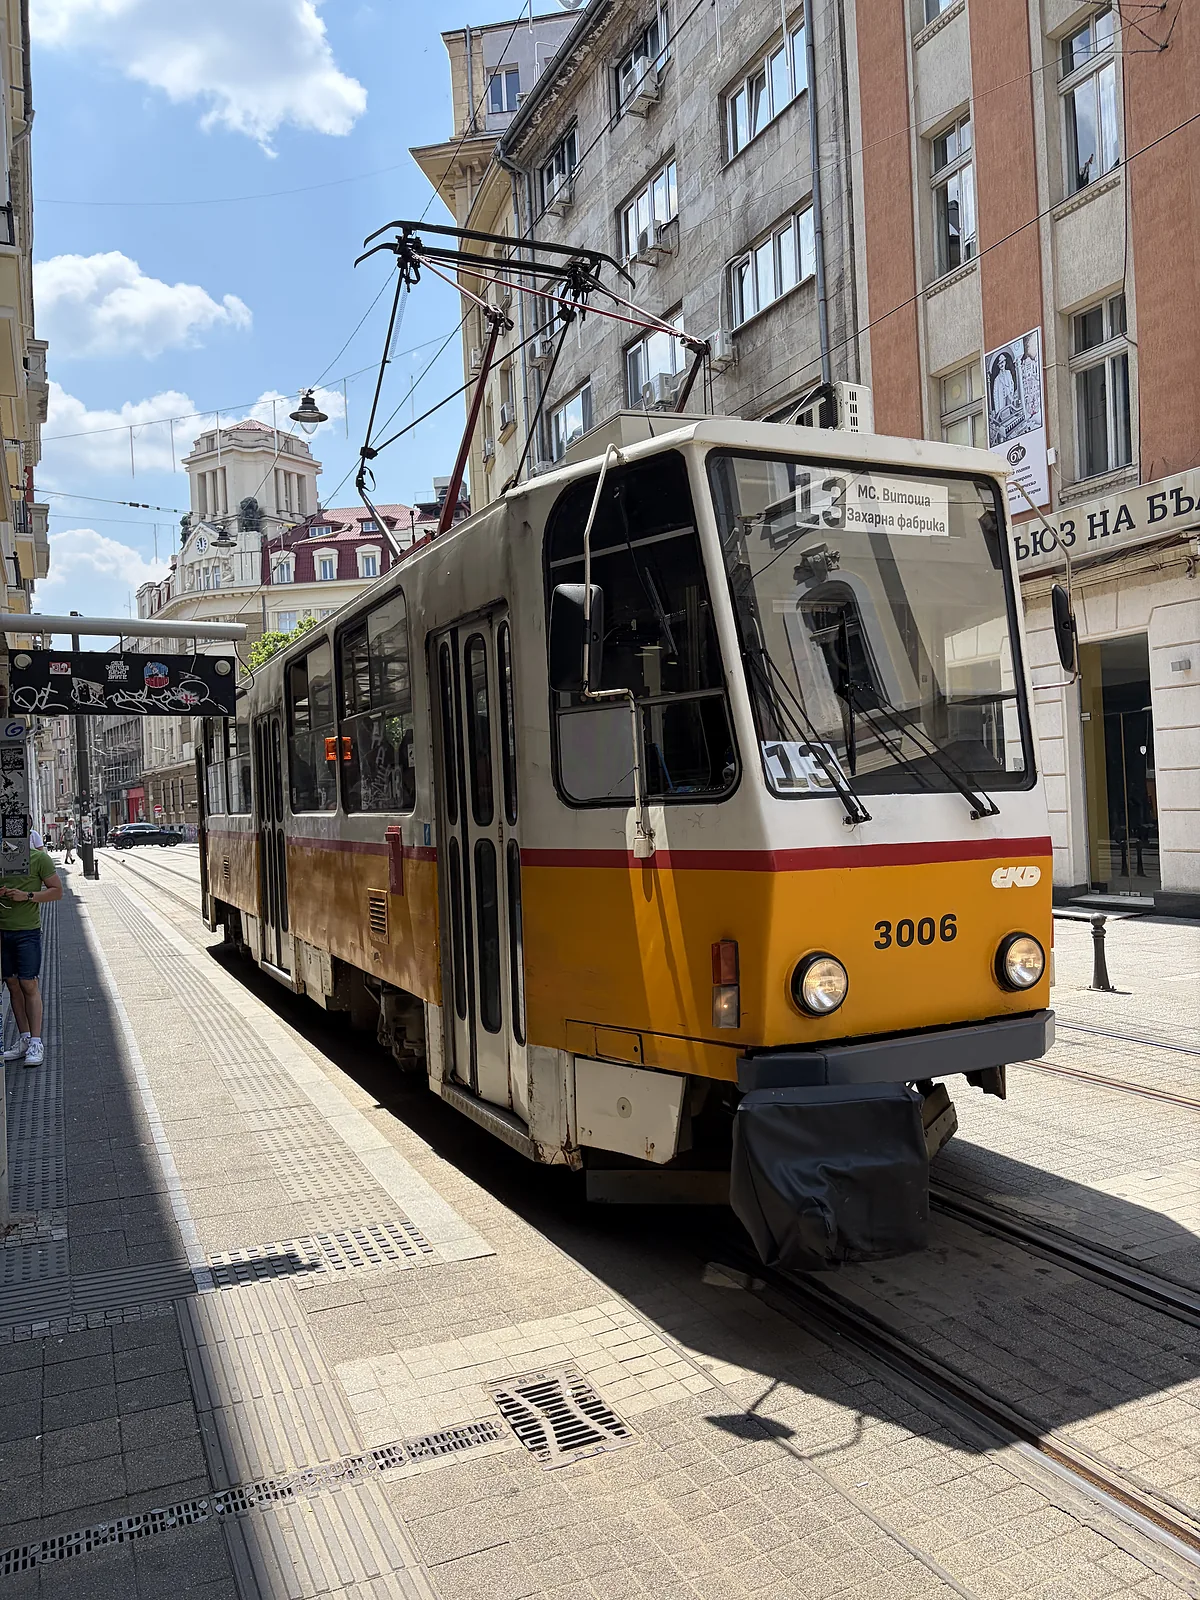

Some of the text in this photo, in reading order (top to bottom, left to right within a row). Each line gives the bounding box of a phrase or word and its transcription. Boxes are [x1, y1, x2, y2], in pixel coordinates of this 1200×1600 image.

[795, 473, 847, 529] 13
[857, 484, 931, 507] МС. Витоша
[847, 507, 946, 533] Захарна фабрика
[1087, 503, 1136, 541] НА
[764, 743, 841, 789] 13
[873, 913, 958, 950] 3006
